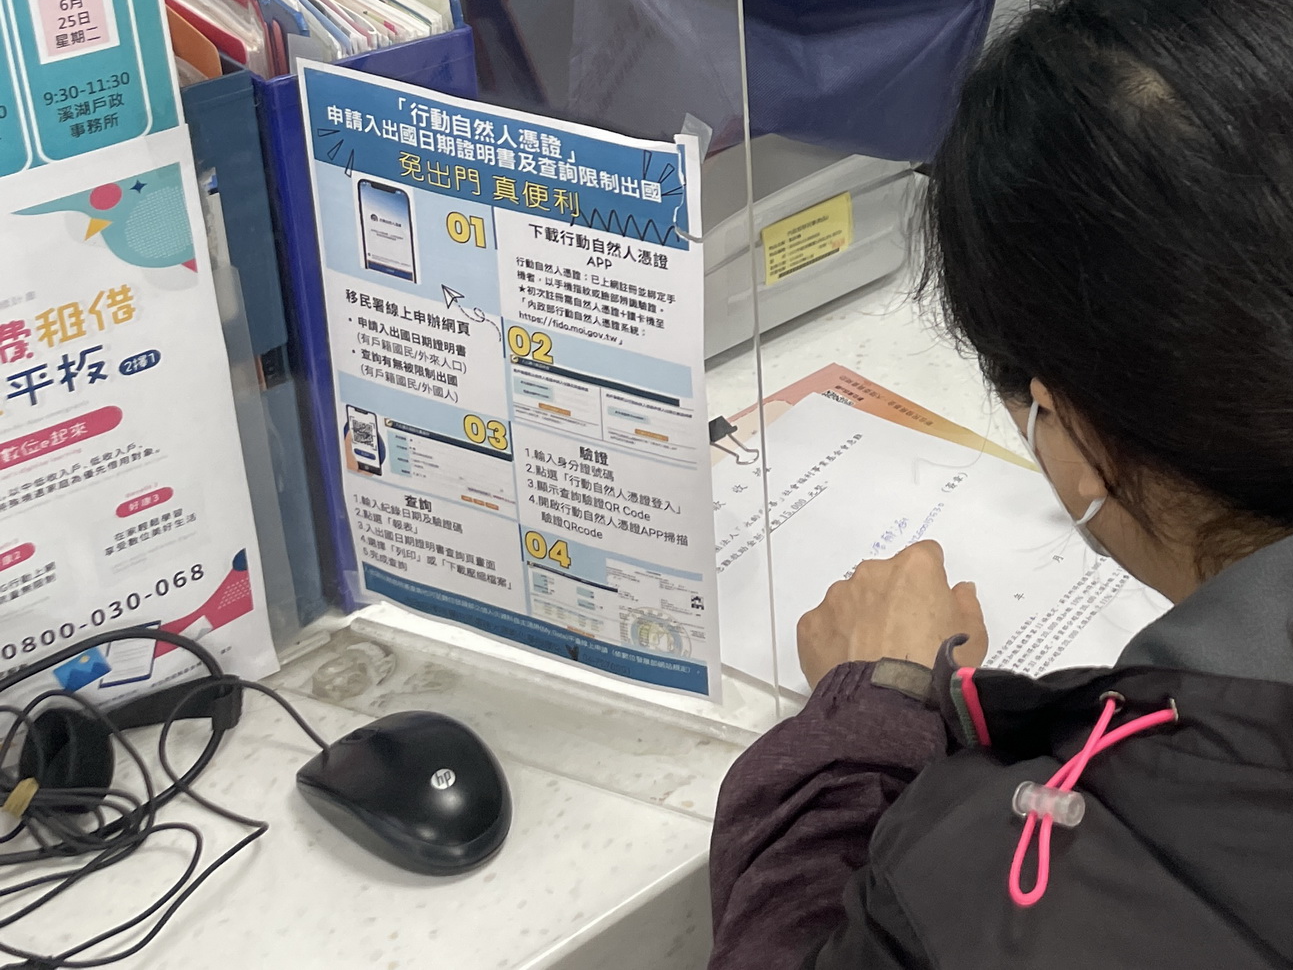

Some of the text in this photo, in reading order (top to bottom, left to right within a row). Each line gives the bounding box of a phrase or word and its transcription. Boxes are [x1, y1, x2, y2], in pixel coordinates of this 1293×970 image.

[55, 26, 102, 49] 星期二
[58, 12, 91, 30] 25日
[43, 71, 130, 106] 9:30-11:30
[57, 92, 125, 123] 溪湖戶政
[69, 113, 120, 138] 事務所
[397, 97, 577, 163] 「行動自然人憑證」
[327, 105, 662, 203] 申請入出國日期證明書及查詢限制出國
[398, 152, 580, 218] 免出門 真便利
[446, 210, 487, 248] 01
[528, 223, 669, 271] 下載行動自然人憑證
[587, 256, 613, 271] APP
[345, 289, 471, 337] 移民署線上申辦網頁
[358, 317, 466, 358] 申請入出國日期證明書
[508, 325, 554, 364] 02
[123, 351, 158, 374] 2擇1
[361, 349, 458, 387] 查詢有無被限制出國
[463, 414, 508, 450] 03
[579, 446, 609, 467] 驗證
[404, 494, 432, 513] 查詢
[623, 505, 651, 522] Code
[524, 530, 572, 569] 04
[2, 563, 205, 660] 0800-030-068
[433, 770, 453, 788] hp
